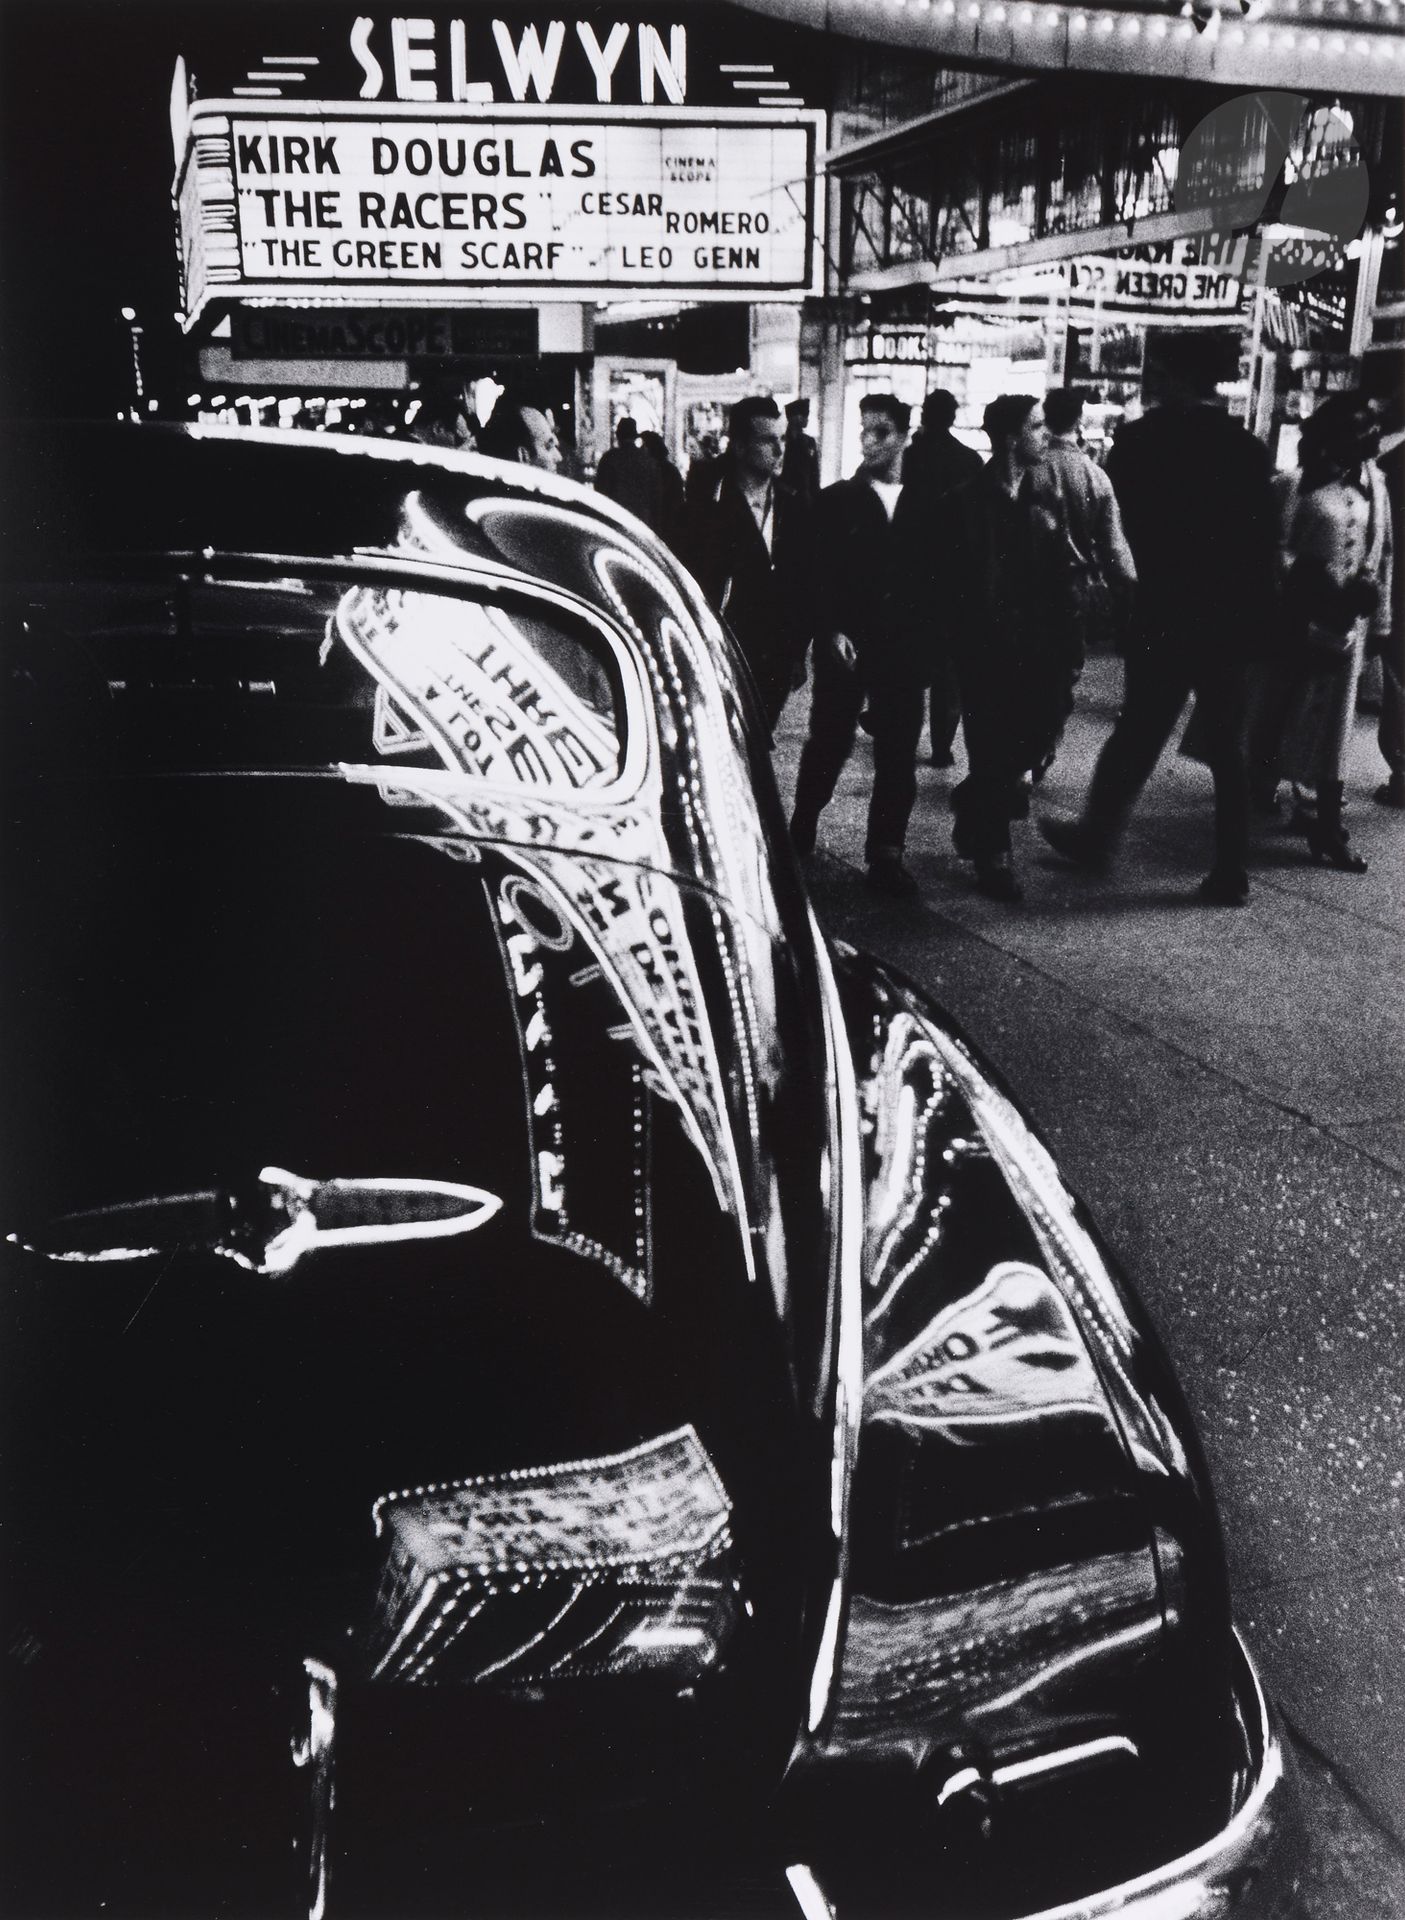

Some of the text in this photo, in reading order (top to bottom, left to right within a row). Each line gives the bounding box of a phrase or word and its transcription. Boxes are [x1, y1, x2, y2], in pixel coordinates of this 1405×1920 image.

[350, 16, 688, 103] SELWYN
[238, 135, 597, 178] KIRK DOUGLAS
[581, 192, 664, 216] CESAR
[666, 212, 770, 235] ROMERO
[332, 239, 442, 269] GREEN
[622, 246, 672, 269] LEO
[694, 246, 760, 269] GENN
